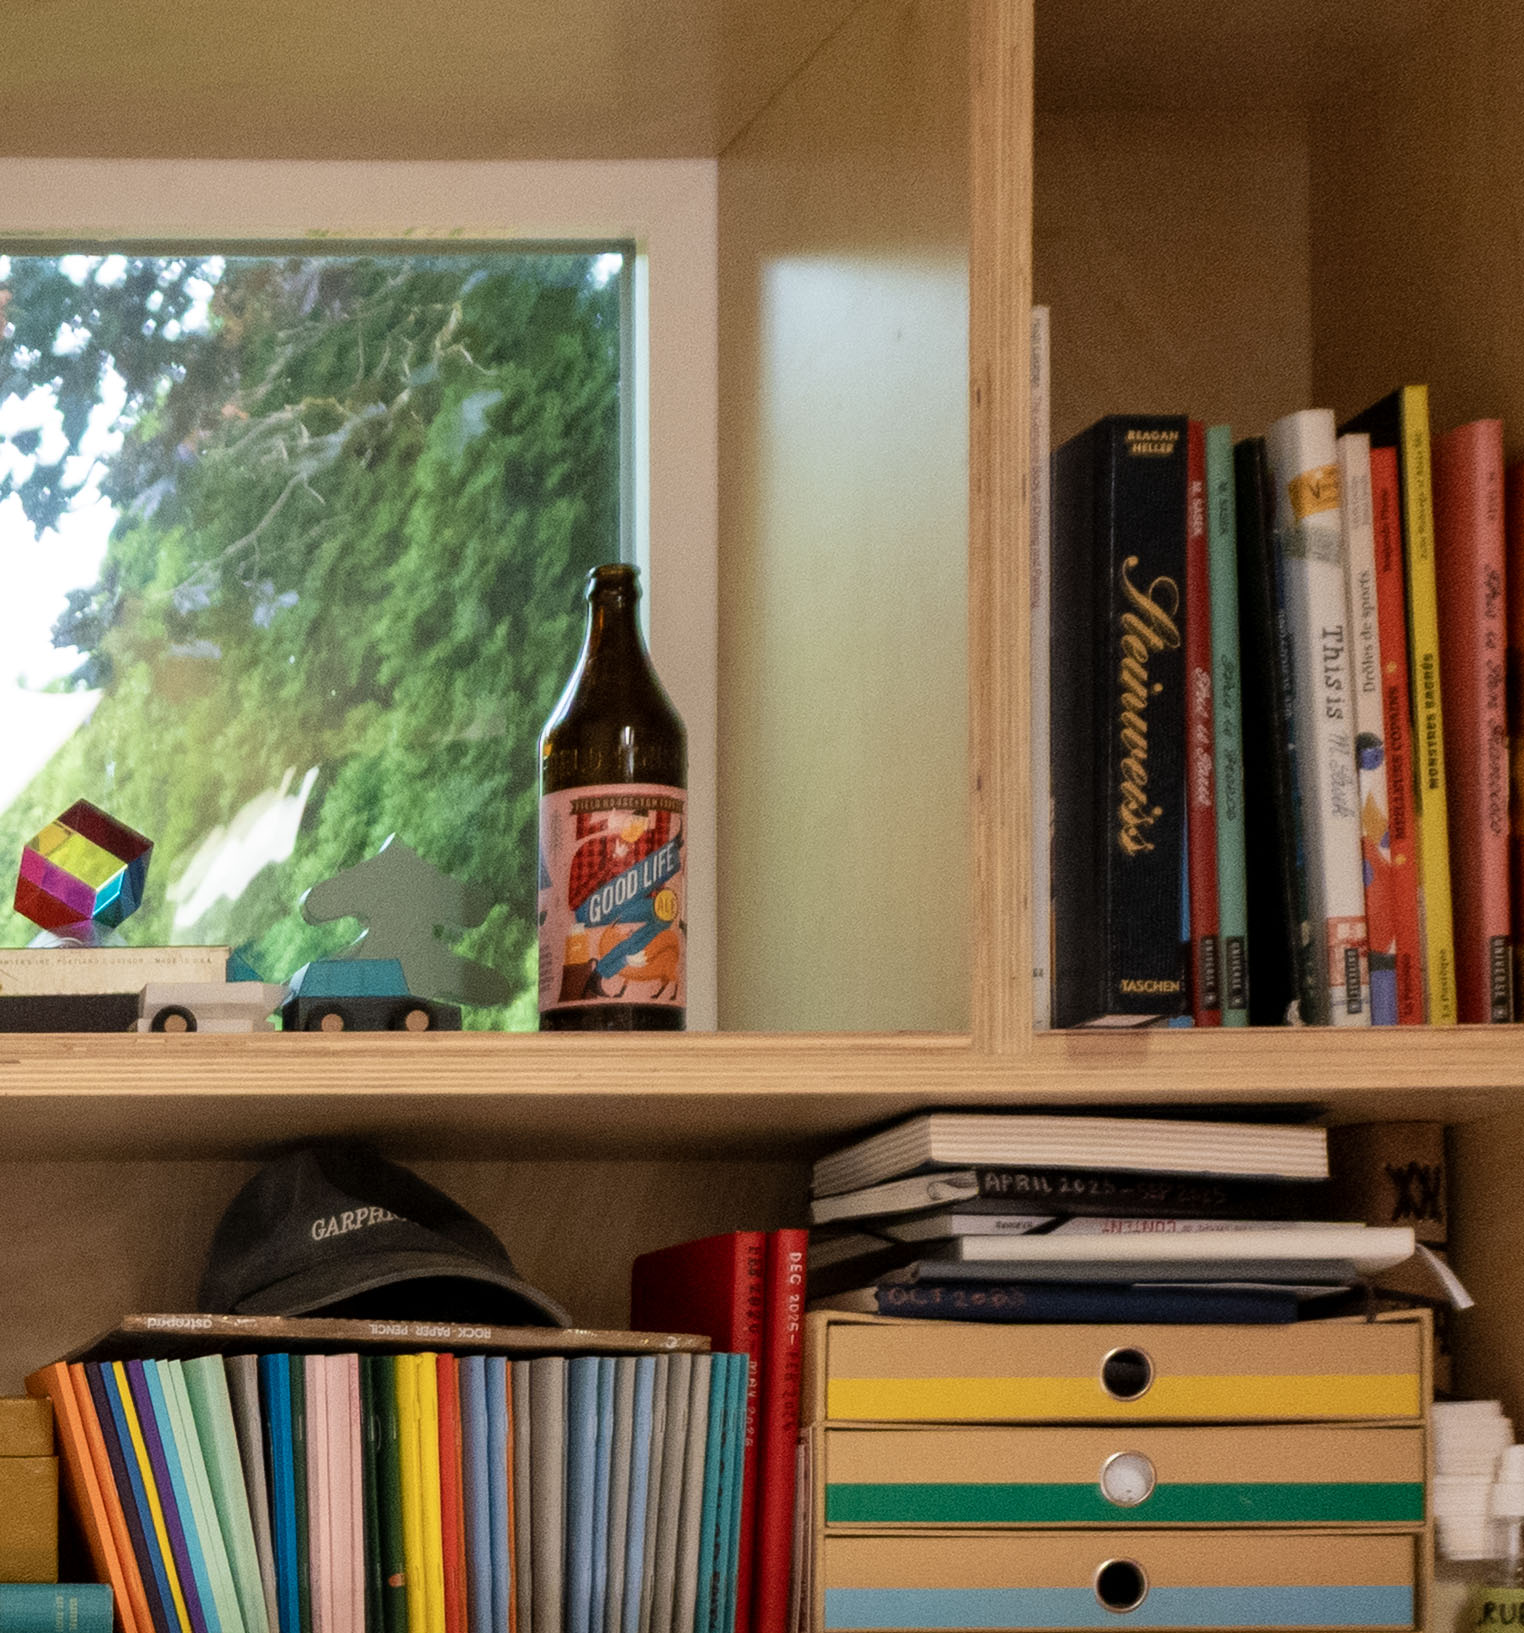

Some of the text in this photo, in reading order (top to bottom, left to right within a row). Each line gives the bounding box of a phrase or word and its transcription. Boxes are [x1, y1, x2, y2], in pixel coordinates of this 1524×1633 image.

[1321, 626, 1346, 721] This is
[1118, 556, 1180, 856] Steinweiss
[588, 845, 676, 924] GOOD LIFE
[1120, 978, 1182, 994] TASCHEN
[984, 1172, 1052, 1194] APRIL
[311, 1206, 404, 1242] GARPH
[789, 1250, 803, 1287] DEC
[146, 1317, 213, 1330] astropad
[369, 1324, 492, 1339] ROCK PAPER PENCIL
